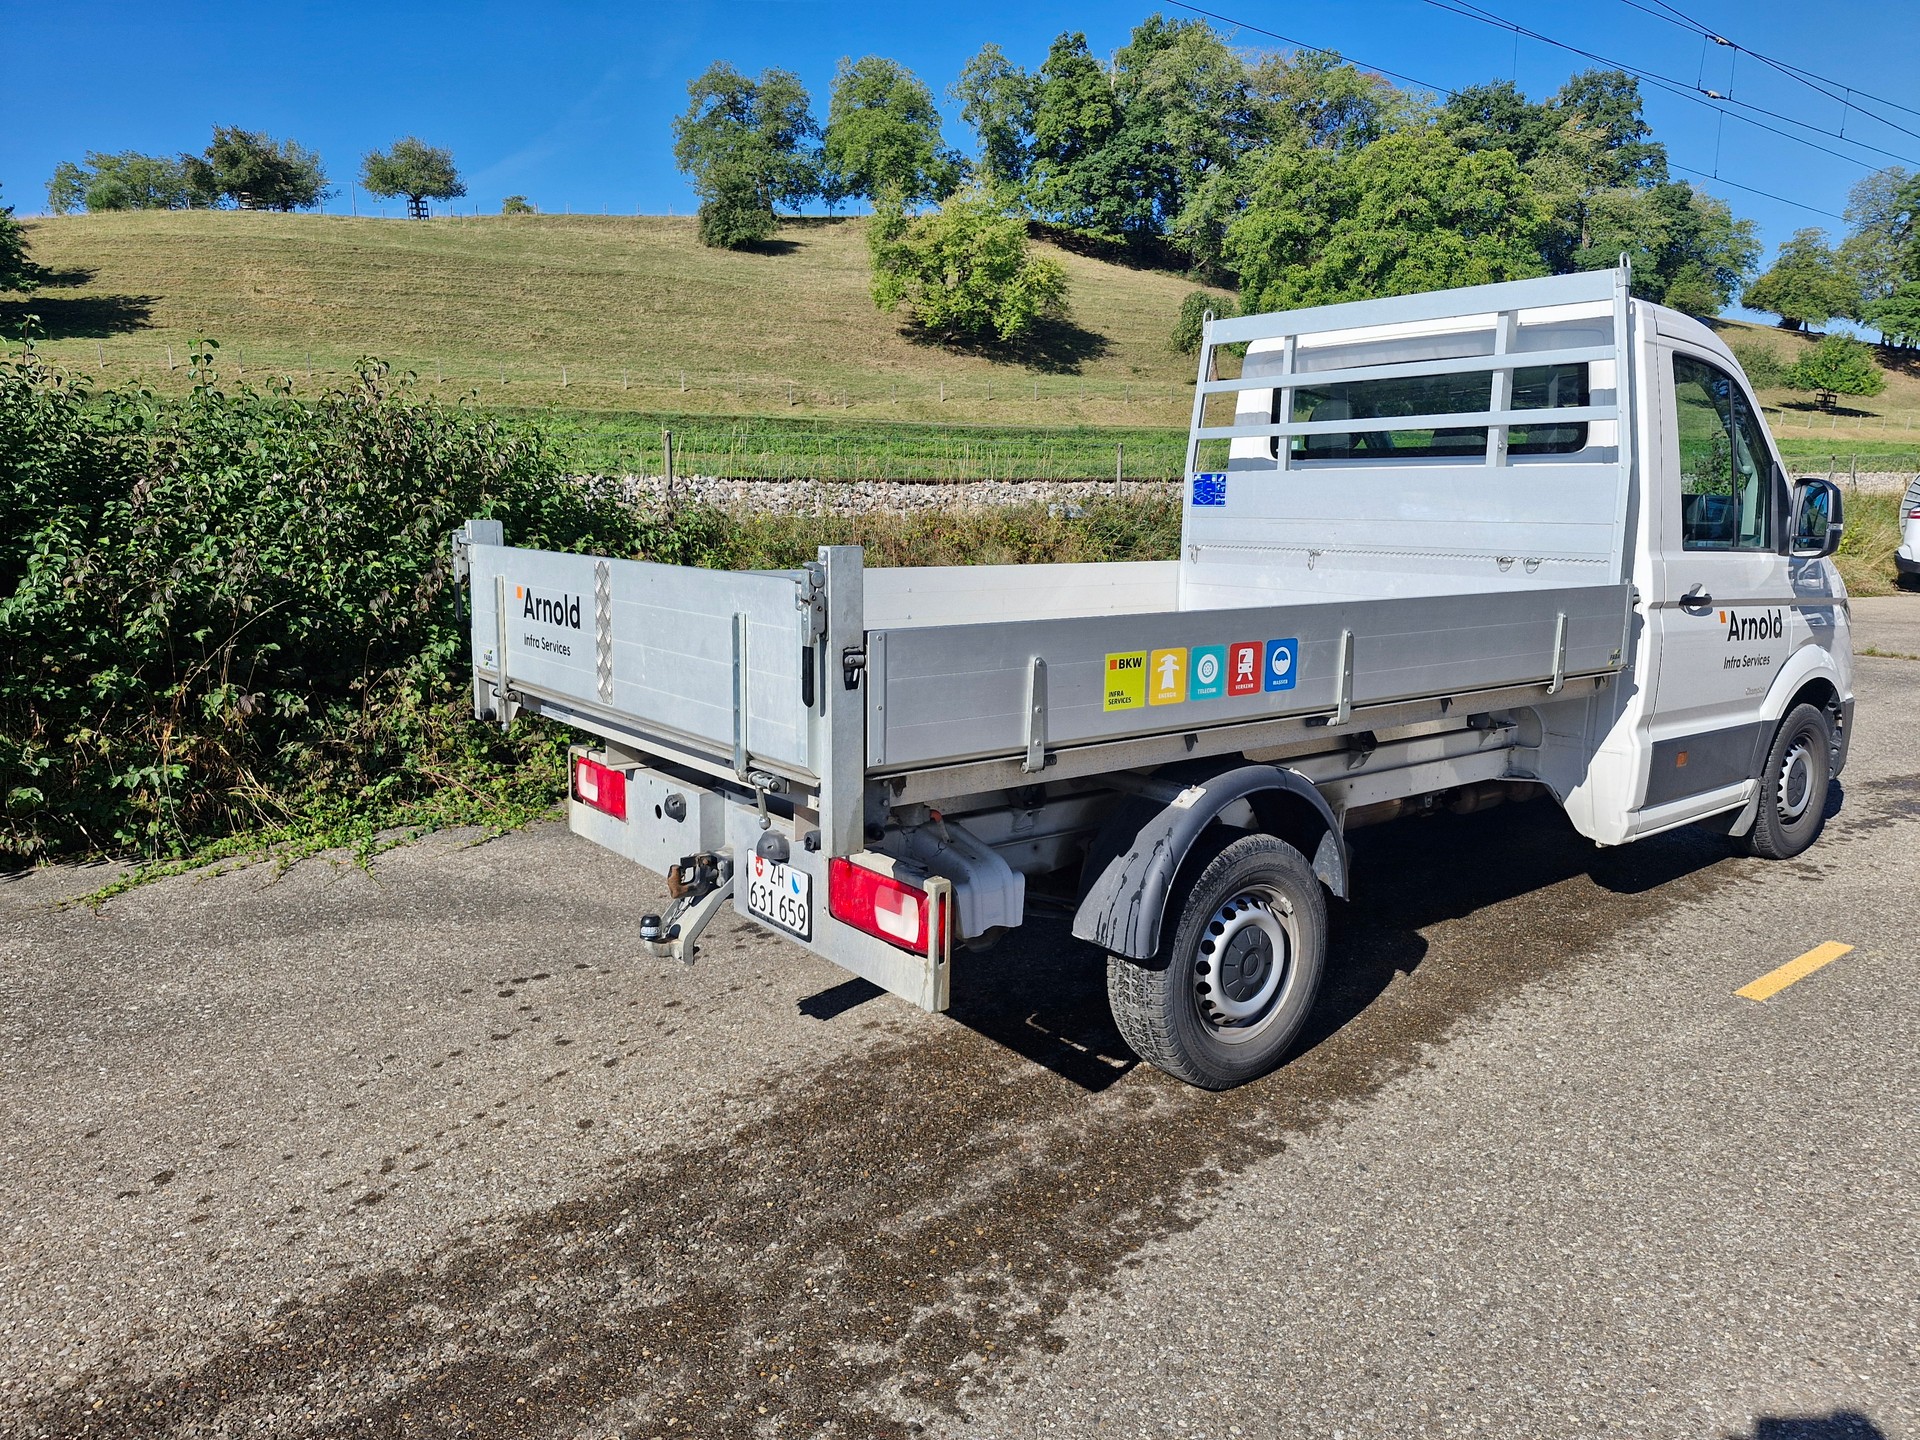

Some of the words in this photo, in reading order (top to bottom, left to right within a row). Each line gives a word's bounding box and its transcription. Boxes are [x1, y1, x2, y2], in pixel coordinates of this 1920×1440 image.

[523, 588, 581, 629] Arnold
[1727, 609, 1783, 642] Arnold
[524, 633, 540, 648] Infra
[541, 637, 571, 656] Services
[1118, 657, 1142, 670] BKW
[1723, 656, 1741, 669] Infra
[1742, 653, 1771, 667] Services
[1108, 690, 1124, 698] INFRA
[1197, 687, 1217, 695] TELECOM
[1108, 697, 1132, 706] SERVICES
[770, 865, 784, 889] ZH
[750, 881, 775, 917] 631
[779, 895, 806, 931] 659
